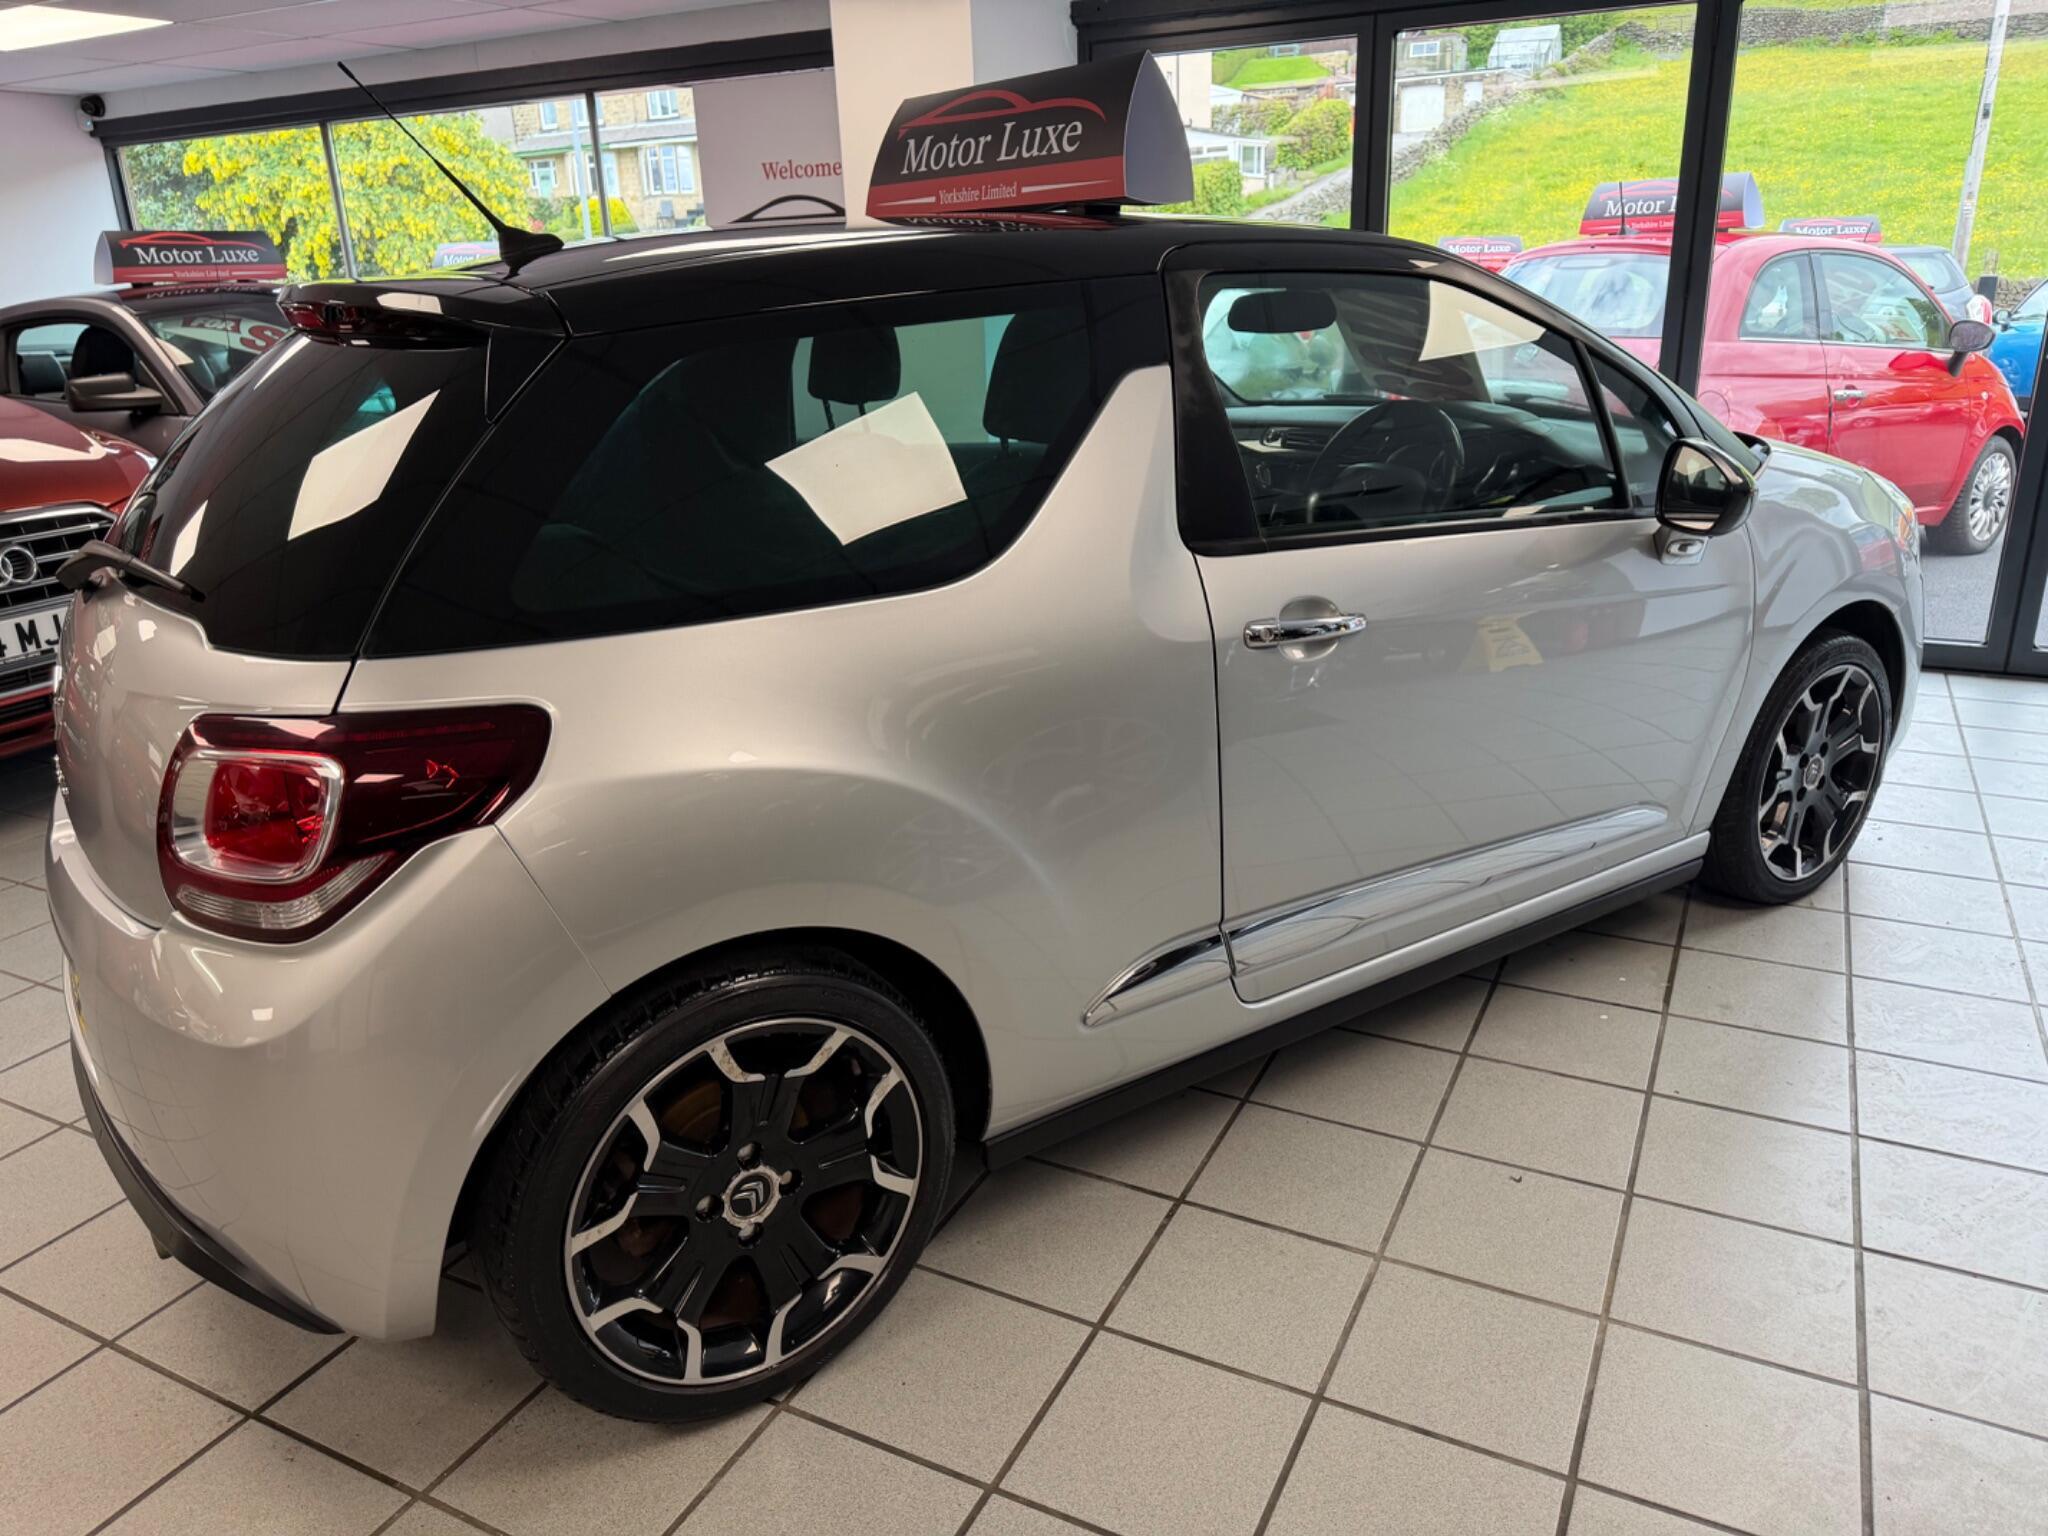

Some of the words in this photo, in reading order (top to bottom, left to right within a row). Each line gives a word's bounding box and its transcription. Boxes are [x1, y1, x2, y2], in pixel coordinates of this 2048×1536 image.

[900, 130, 992, 175] Motor
[996, 119, 1083, 163] Luxe
[761, 159, 843, 181] Welcome
[938, 187, 980, 205] Yorkshire
[981, 181, 1018, 200] Limited
[1603, 198, 1666, 217] Motor
[1795, 225, 1835, 236] Motor
[133, 246, 203, 264] Motor
[206, 245, 260, 263] Luxe
